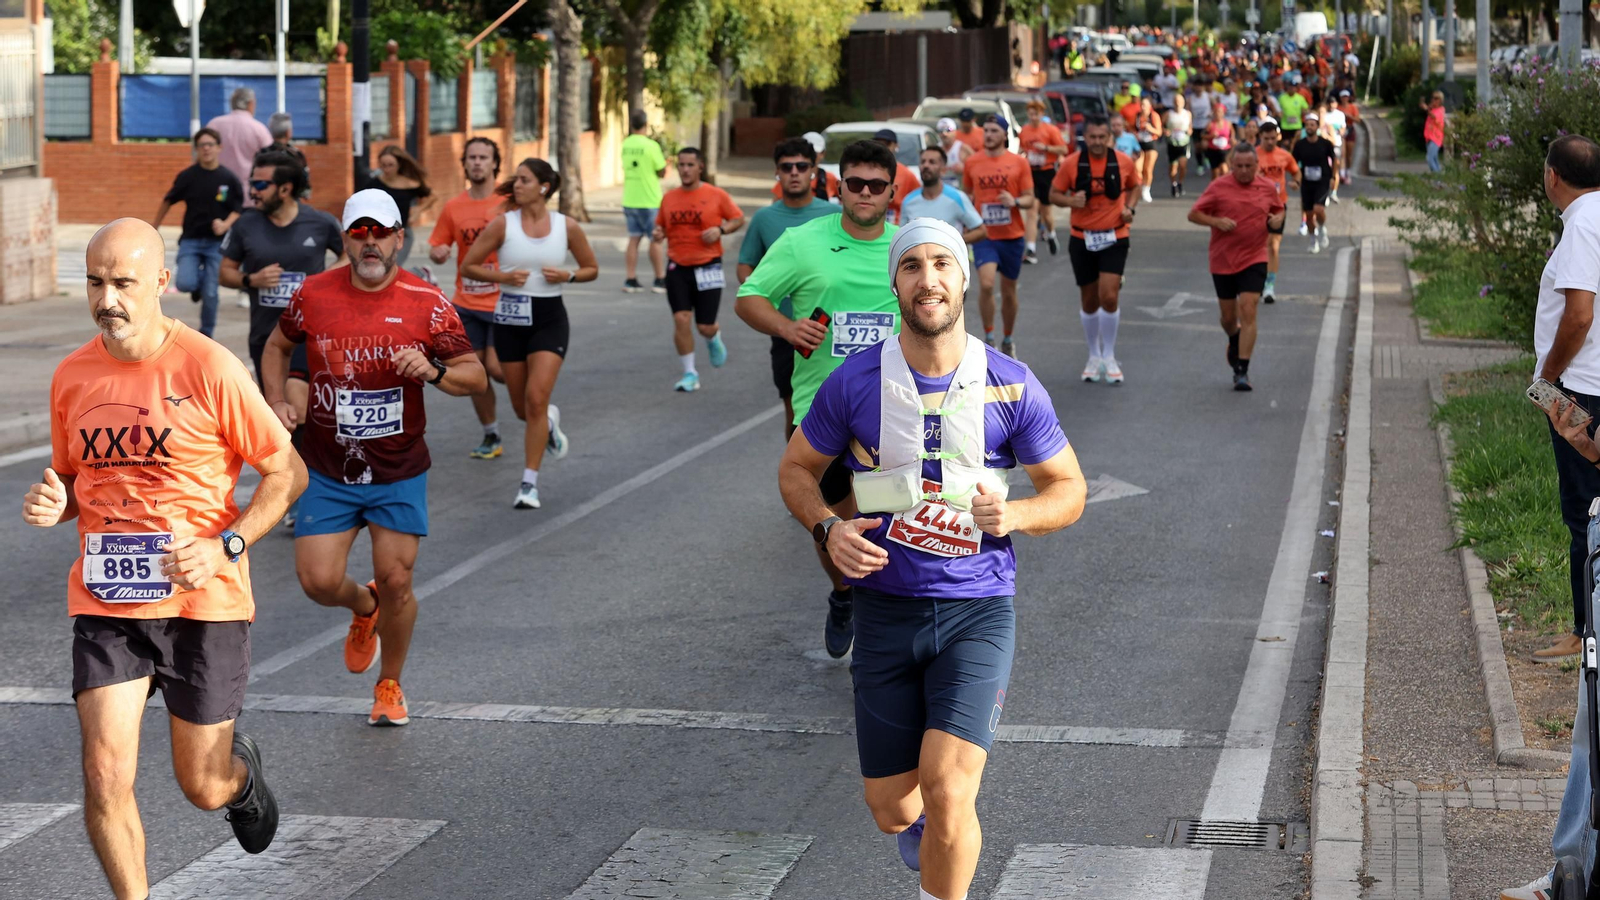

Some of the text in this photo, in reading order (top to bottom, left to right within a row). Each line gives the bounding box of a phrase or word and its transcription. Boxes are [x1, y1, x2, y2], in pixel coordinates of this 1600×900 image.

[501, 303, 520, 315] 852
[332, 334, 393, 350] MEDIO
[848, 327, 880, 343] 973
[313, 382, 334, 412] 30
[353, 406, 388, 423] 920
[914, 504, 962, 536] 444
[103, 557, 151, 580] 885
[113, 586, 168, 598] MIZUNO
